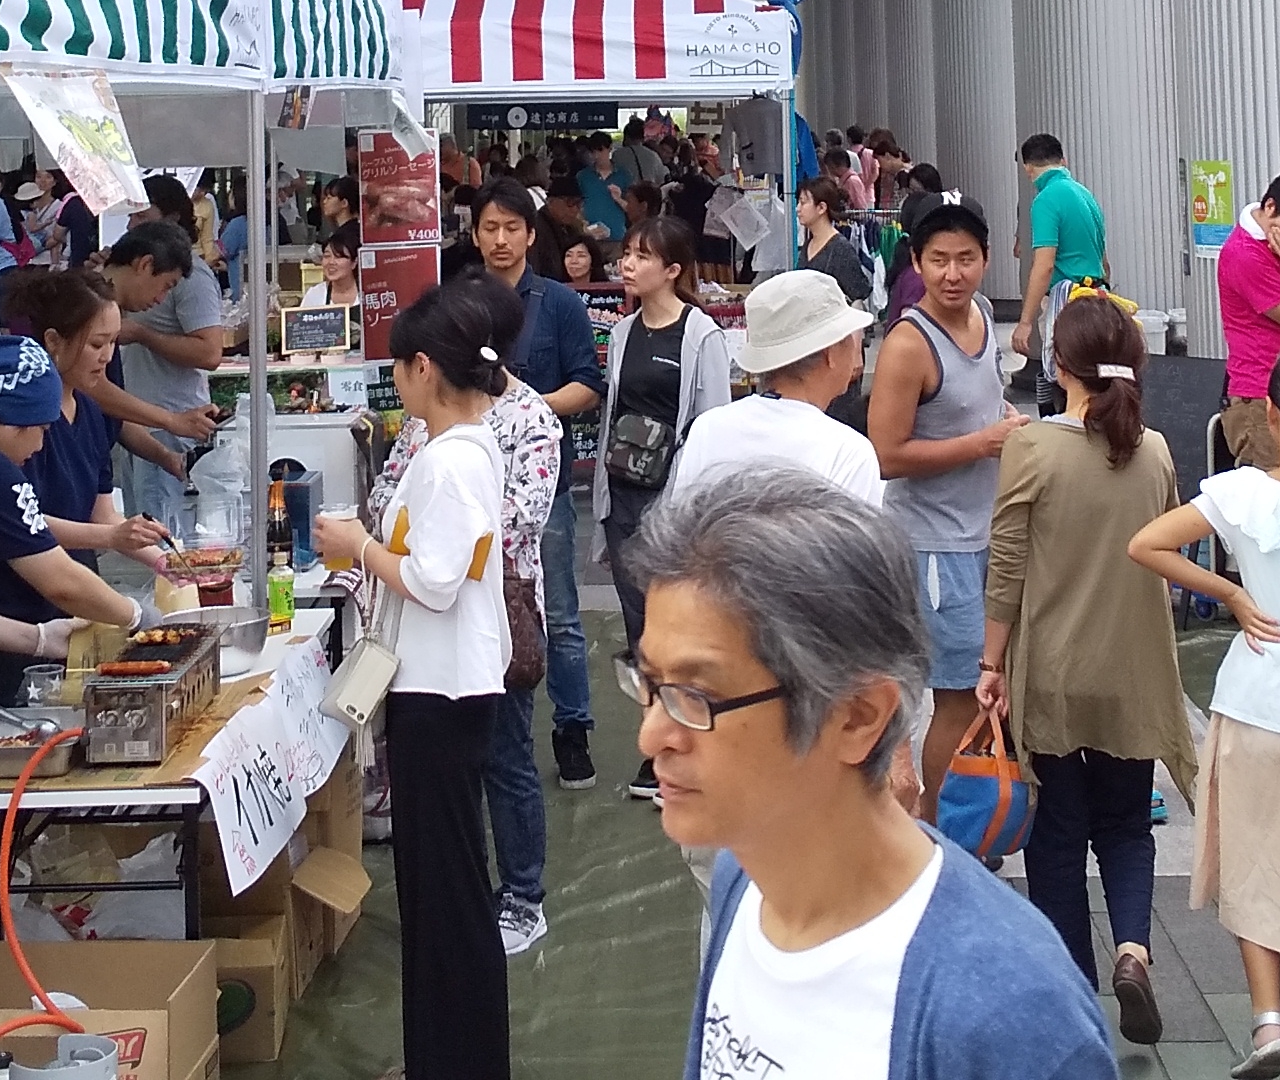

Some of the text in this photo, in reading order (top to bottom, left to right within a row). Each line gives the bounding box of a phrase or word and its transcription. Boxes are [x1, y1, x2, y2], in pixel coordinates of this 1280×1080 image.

[686, 41, 781, 57] HAMACHO
[362, 158, 435, 179] グリルソーセージ
[408, 229, 439, 240] ¥400
[365, 291, 397, 310] 馬肉
[366, 308, 400, 327] ソー
